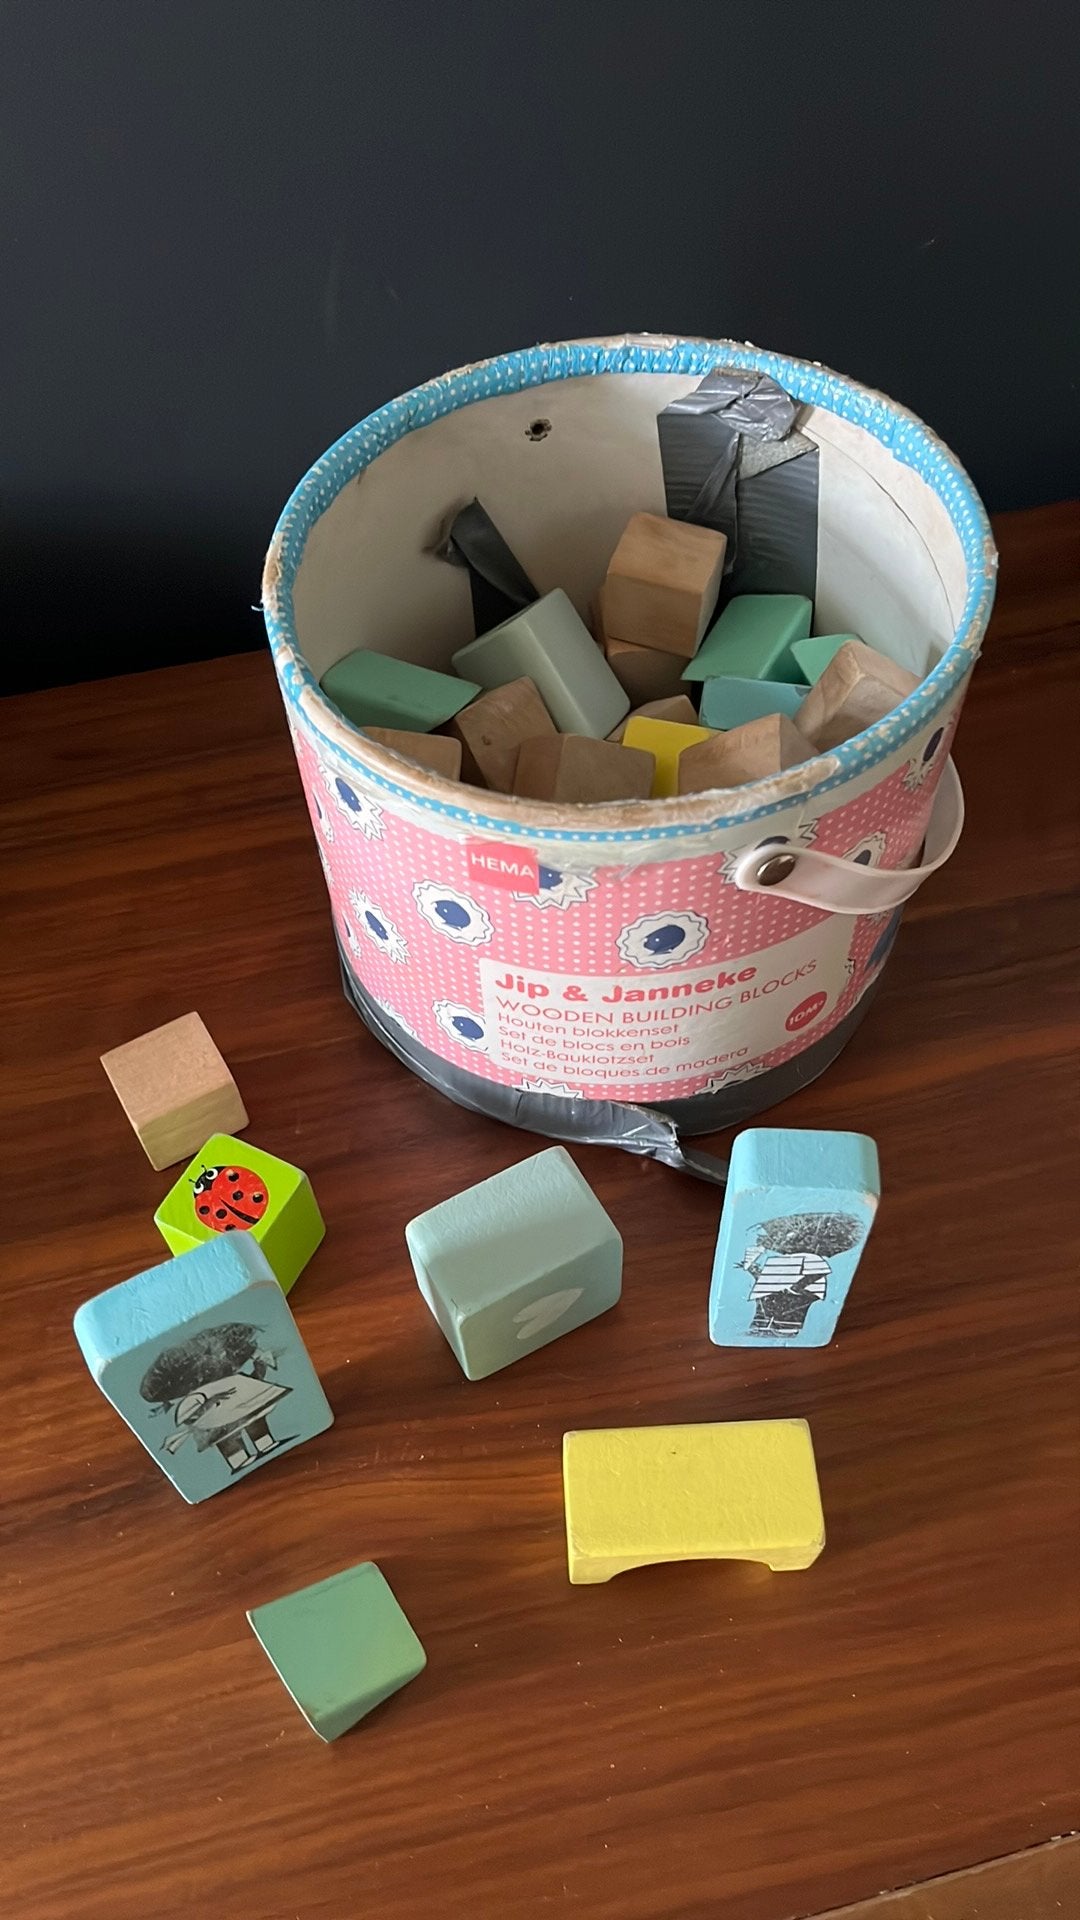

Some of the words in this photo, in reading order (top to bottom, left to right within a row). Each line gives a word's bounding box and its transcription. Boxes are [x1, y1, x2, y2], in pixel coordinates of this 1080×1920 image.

[471, 852, 535, 879] HEMA
[495, 973, 549, 999] Jip
[562, 985, 588, 1001] &
[602, 966, 757, 1003] Janneke
[496, 996, 613, 1024] WOODEN
[622, 996, 733, 1024] BUILDING
[740, 959, 817, 1003] BLOCKS
[498, 1012, 566, 1035] Houten
[573, 1023, 678, 1038] blokkenset
[498, 1025, 526, 1040] Set
[532, 1034, 557, 1047] de
[563, 1039, 615, 1051] blocs
[620, 1042, 644, 1051] en
[651, 1035, 690, 1049] bois
[500, 1039, 655, 1065] Holz-Bauklotzset
[501, 1051, 528, 1066] Set
[533, 1060, 557, 1072] de
[563, 1065, 640, 1079] bloques
[645, 1066, 670, 1076] de
[676, 1047, 748, 1072] madera
